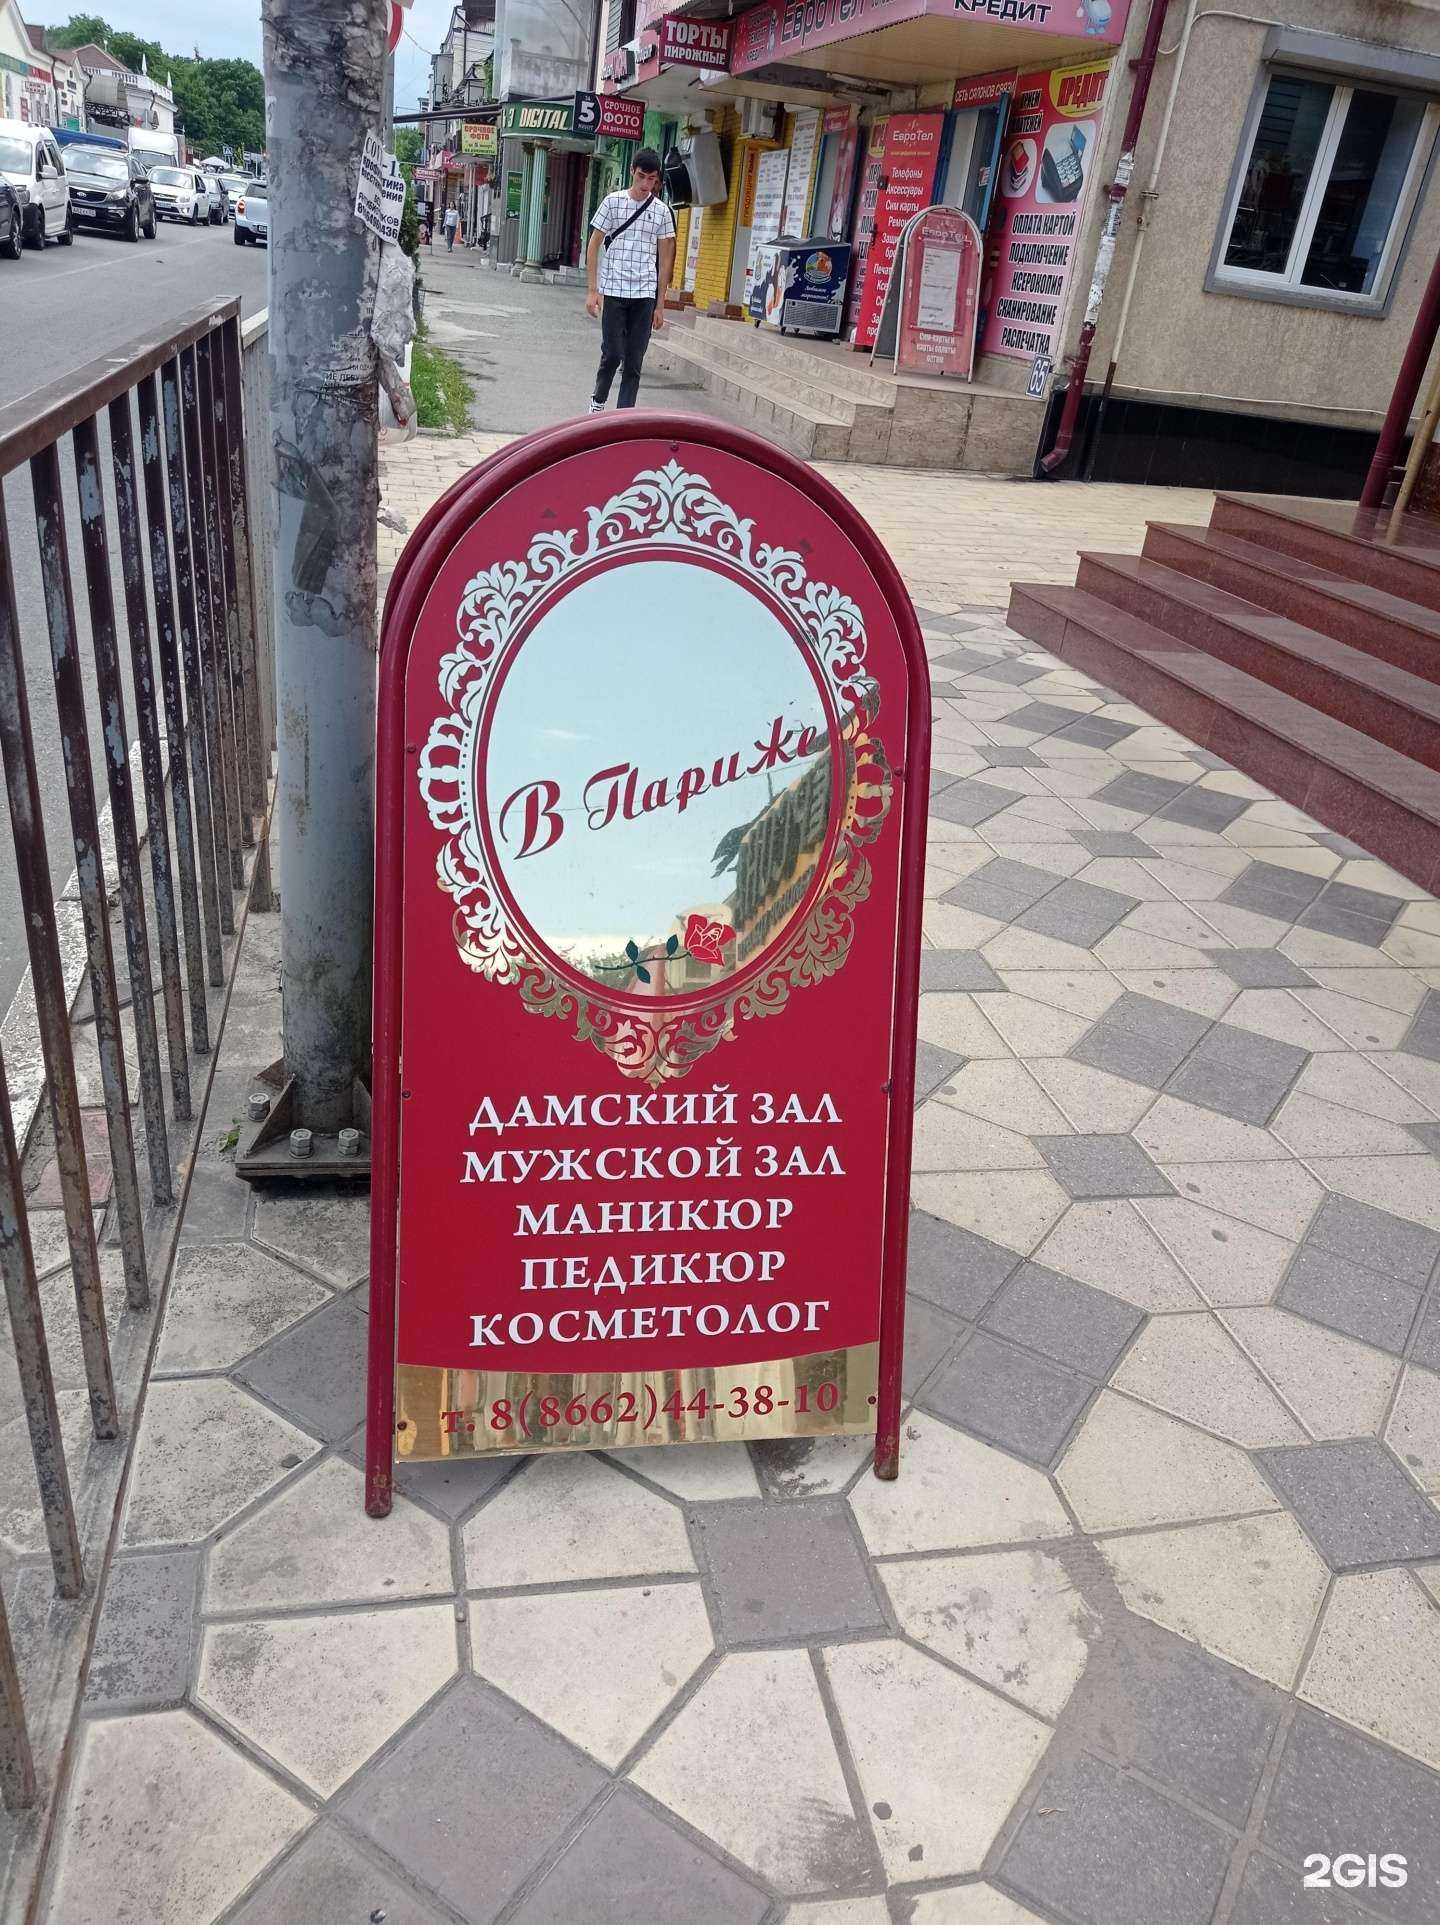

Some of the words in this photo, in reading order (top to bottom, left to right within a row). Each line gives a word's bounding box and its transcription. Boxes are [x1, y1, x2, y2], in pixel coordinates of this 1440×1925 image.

[666, 19, 729, 50] ТОРТЫ
[664, 45, 726, 66] ПИРОЖНЫЕ
[519, 107, 571, 131] DIGITAL
[578, 101, 595, 123] 5
[604, 100, 641, 114] СРОЧНОЕ
[603, 113, 640, 128] ФОТО
[893, 130, 934, 143] ЕвроТел
[891, 167, 923, 181] Телефоны
[885, 184, 924, 198] Аксессуары
[1012, 214, 1042, 235] ОПЛАТА
[1042, 210, 1076, 236] КАРТОЙ
[1008, 242, 1070, 266] ПОДКЛЮЧЕНИЕ
[1010, 271, 1064, 296] КСЕРОКОПИЯ
[996, 297, 1058, 326] СКАНИРОВАНИЕ
[1001, 327, 1051, 354] РАСПЕЧАТКА
[1029, 359, 1049, 393] 65
[499, 780, 564, 860] В
[583, 716, 818, 831] Париже
[469, 1084, 738, 1136] ДАМСКИЙ
[750, 1092, 843, 1124] ЗАЛ
[459, 1136, 742, 1184] МУЖСКОЙ
[754, 1144, 846, 1177] ЗАЛ
[513, 1198, 794, 1236] МАНИКЮР
[519, 1250, 786, 1296] ПЕДИКЮР
[468, 1300, 830, 1347] КОСМЕТОЛОГ
[441, 1408, 475, 1434] т.
[490, 1381, 839, 1438] 8(8662)44-38-10
